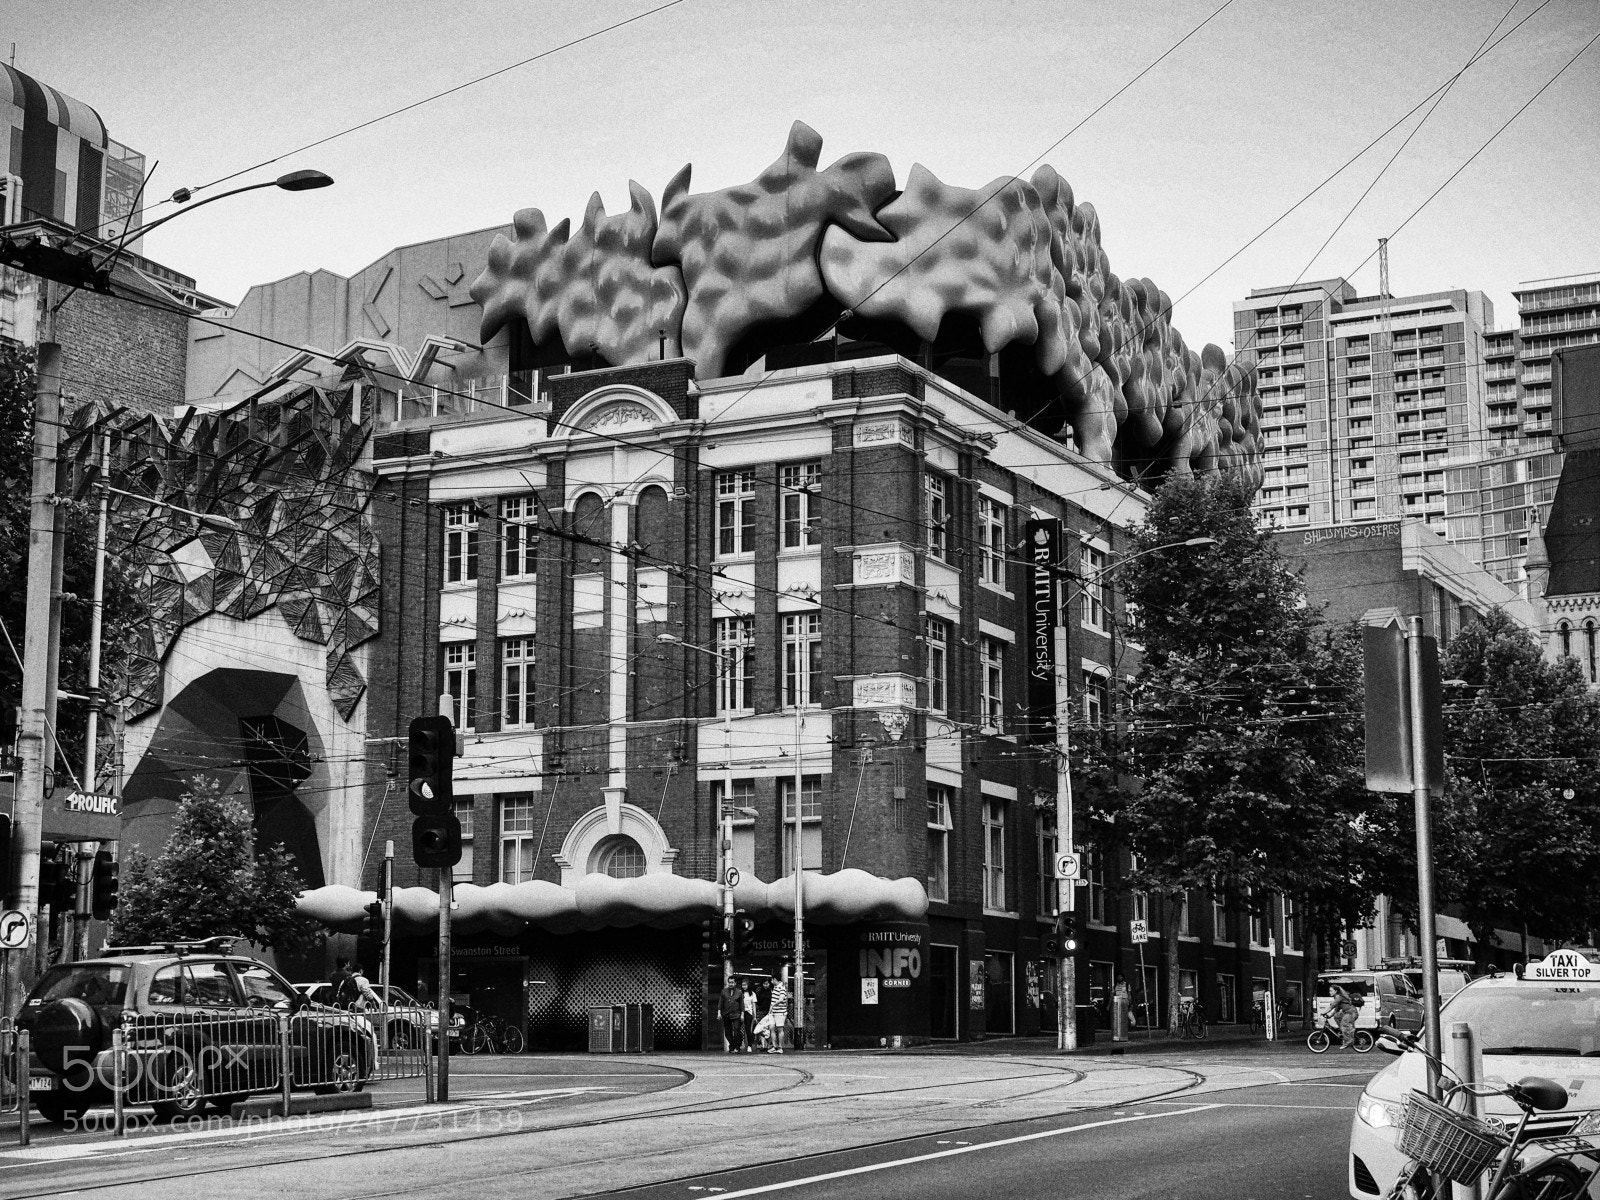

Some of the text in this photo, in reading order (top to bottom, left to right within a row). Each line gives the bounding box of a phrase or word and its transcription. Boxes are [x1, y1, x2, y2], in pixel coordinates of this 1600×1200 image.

[1034, 547, 1051, 599] RMIT
[70, 794, 118, 814] PROLIFIC
[868, 931, 895, 942] RMIT
[1132, 933, 1147, 941] LANE
[781, 938, 811, 949] Stret
[451, 946, 492, 956] Swanston
[494, 945, 520, 955] Street
[859, 947, 921, 978] INFO
[1536, 967, 1591, 978] SILVER TOP
